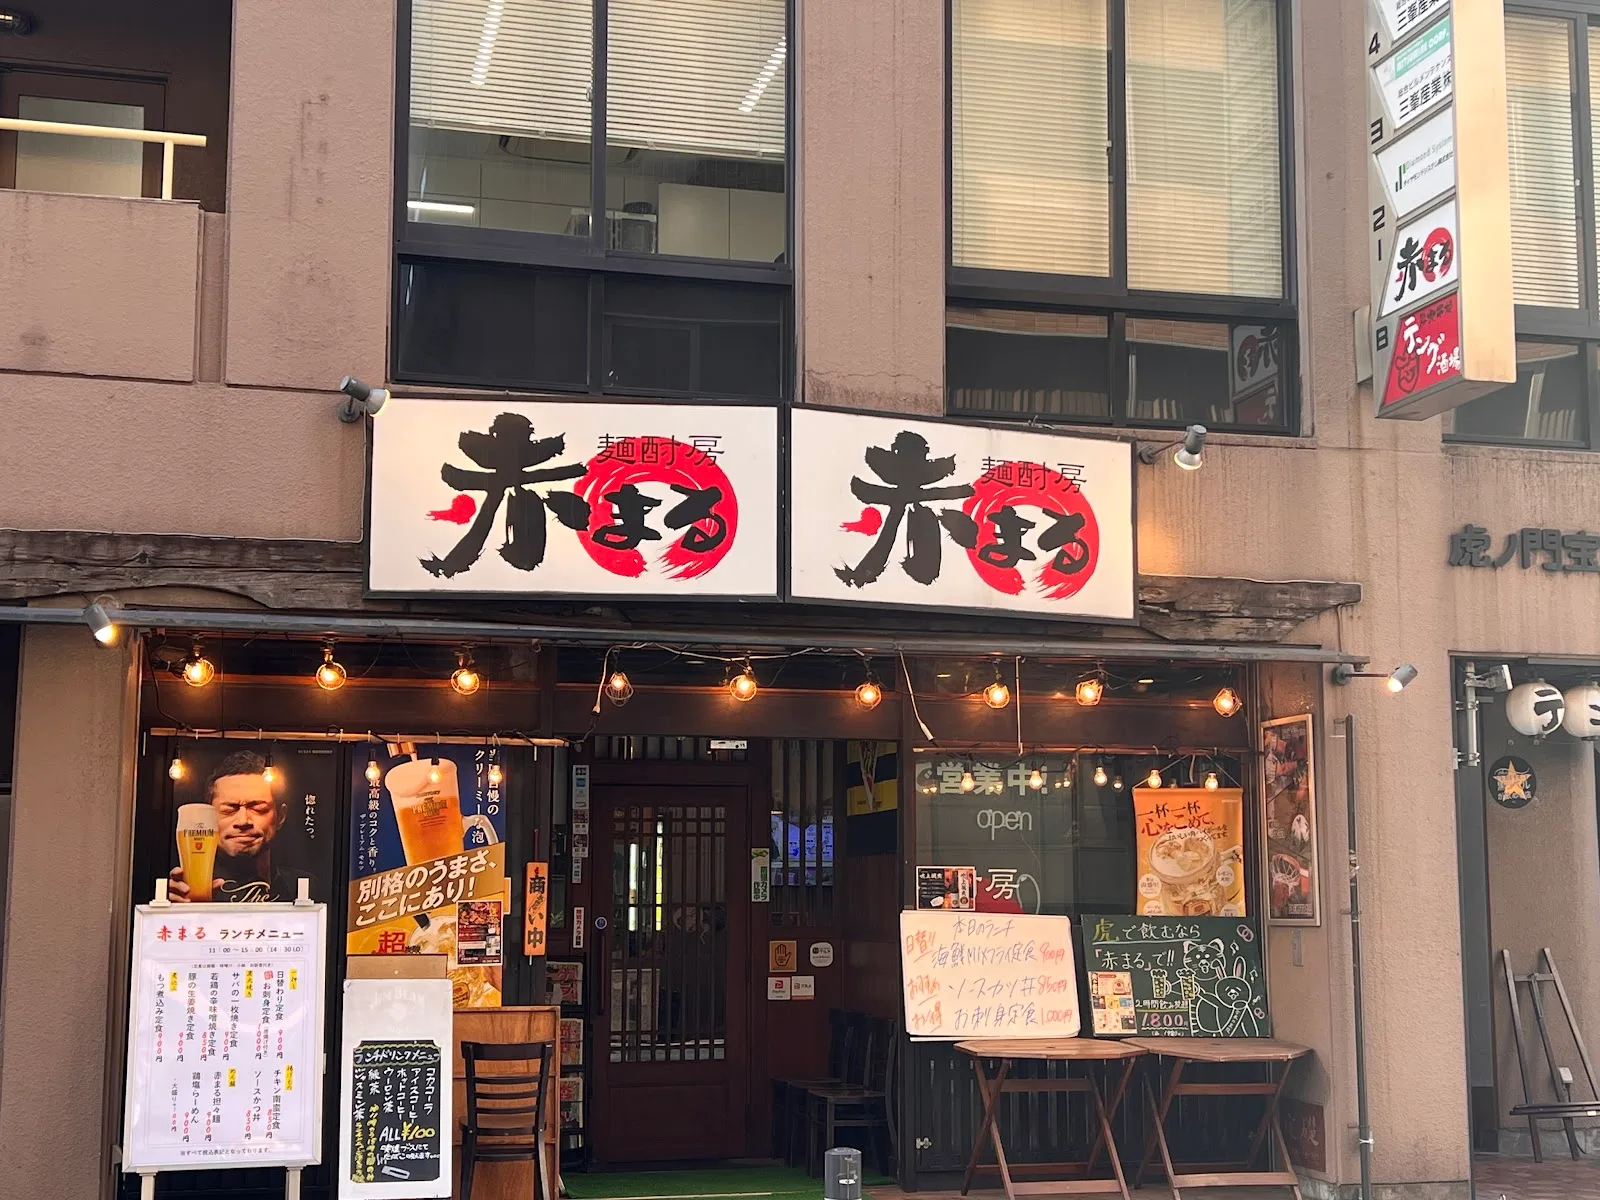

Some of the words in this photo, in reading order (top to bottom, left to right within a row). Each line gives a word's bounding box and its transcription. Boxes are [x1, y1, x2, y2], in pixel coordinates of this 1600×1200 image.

[1368, 32, 1380, 55] 4
[1370, 117, 1383, 145] 3
[1373, 204, 1385, 232] 2
[1376, 326, 1388, 351] B
[417, 412, 725, 579] 赤まる
[832, 430, 1089, 589] 赤まる
[977, 809, 1032, 840] open
[157, 925, 206, 941] 赤まる
[219, 929, 304, 940] ランチメニュー
[1092, 918, 1201, 942] 虎で飲むなら
[275, 971, 285, 1021] 日替わり定食
[212, 1071, 221, 1124] 赤まる担々麺
[379, 1126, 401, 1141] ALL
